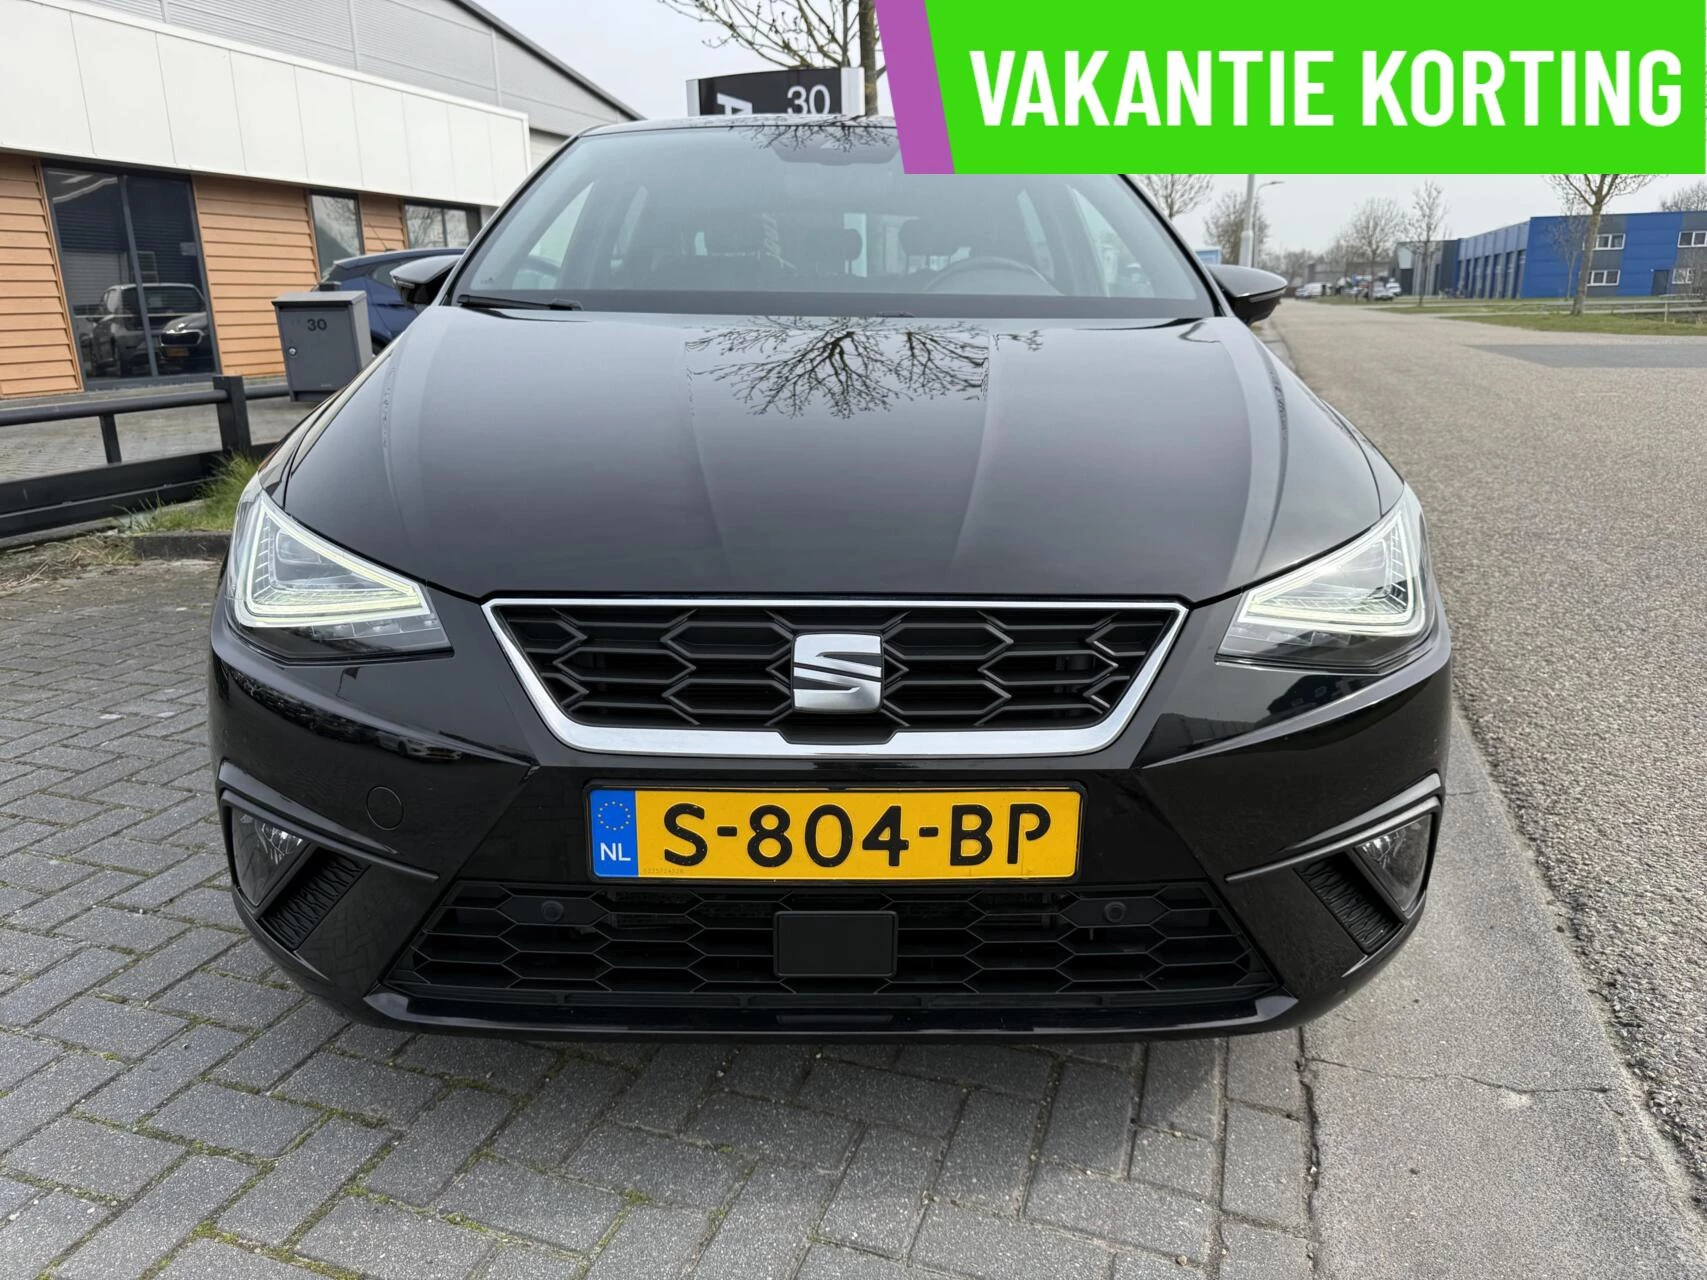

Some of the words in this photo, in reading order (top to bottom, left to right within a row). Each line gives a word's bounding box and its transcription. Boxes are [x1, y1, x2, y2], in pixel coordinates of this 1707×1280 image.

[787, 84, 830, 115] 30
[307, 318, 328, 331] 30
[663, 803, 1051, 867] S-804-BP
[600, 842, 631, 861] NL
